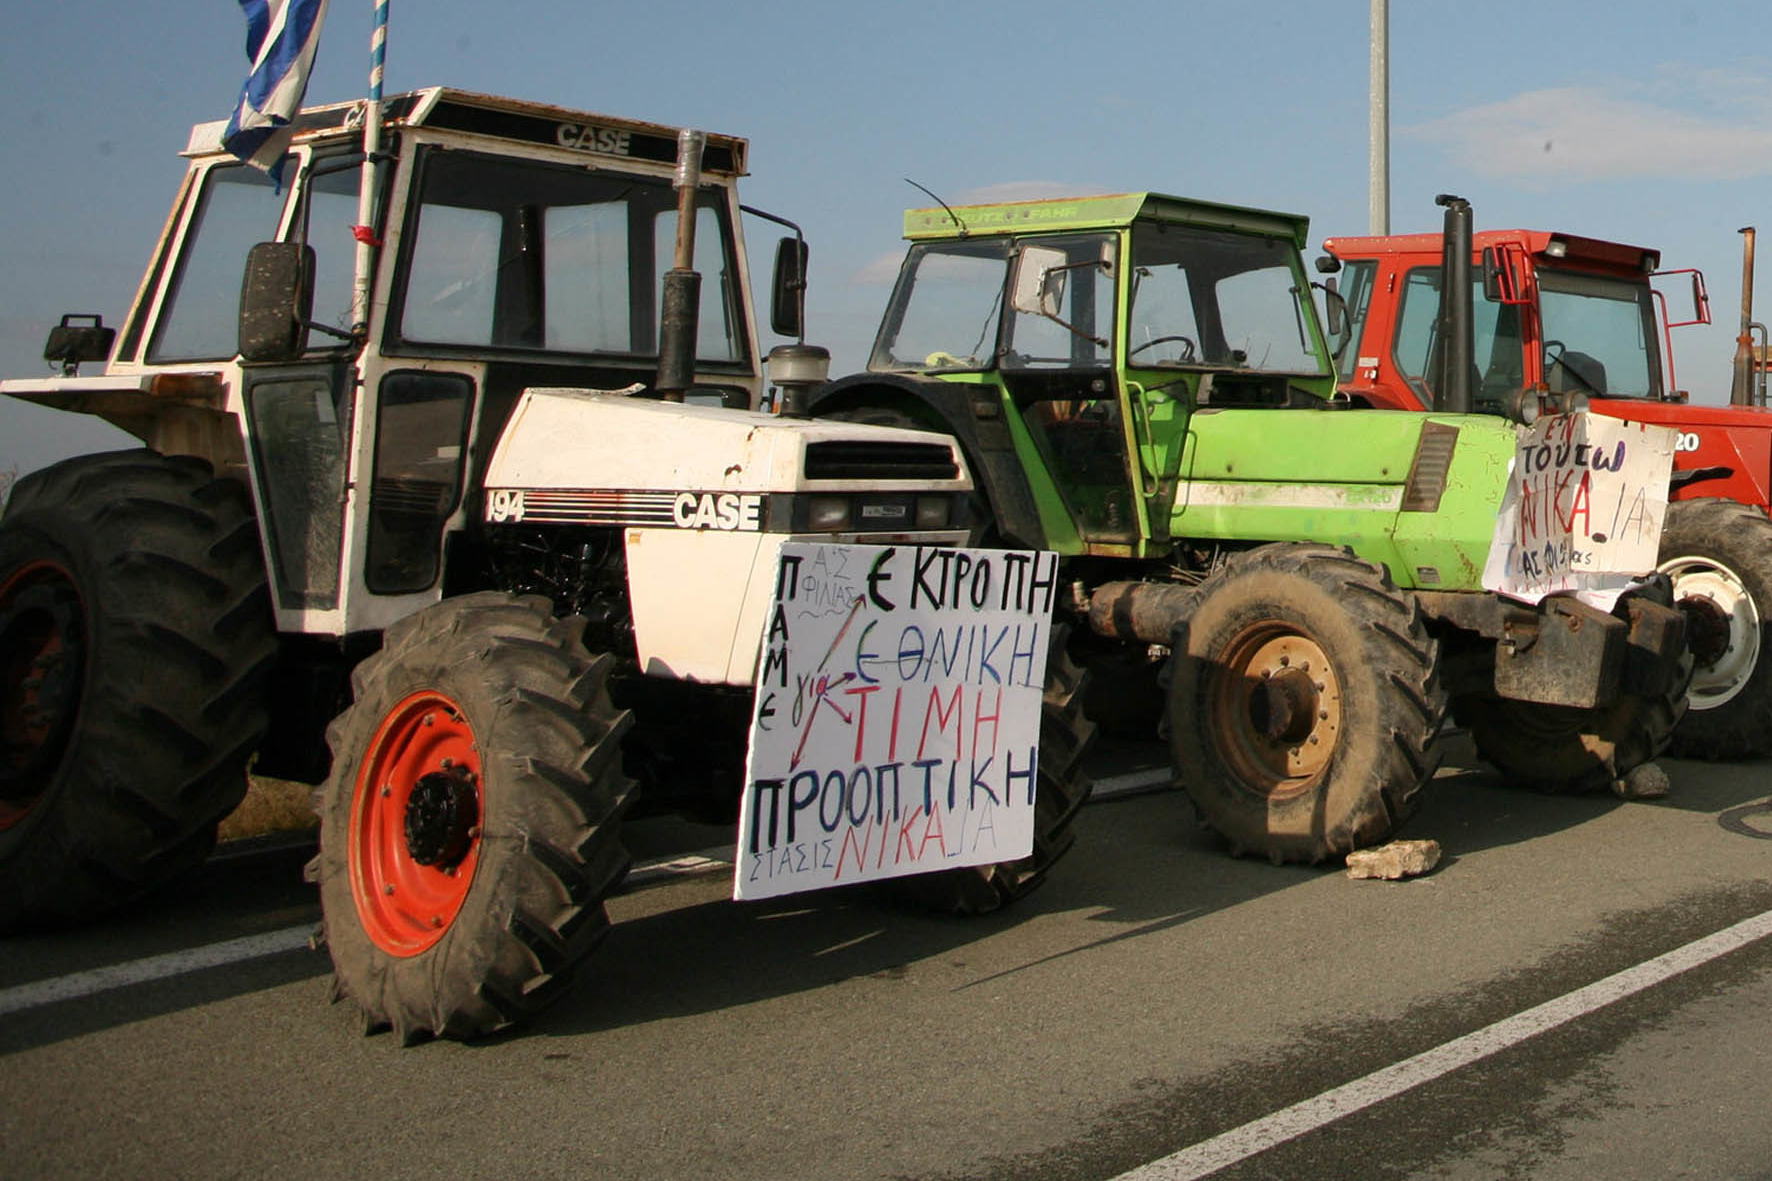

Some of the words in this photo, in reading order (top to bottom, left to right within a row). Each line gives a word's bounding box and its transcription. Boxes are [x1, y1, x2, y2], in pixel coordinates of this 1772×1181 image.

[557, 123, 632, 155] CASE
[673, 492, 760, 530] CASE
[856, 619, 1039, 686] ΕΘΝΙΚΗ
[844, 684, 1002, 763] ΤΙΜΗ
[750, 746, 1036, 854] ΠΡΟΟΠΤΙΚΗ
